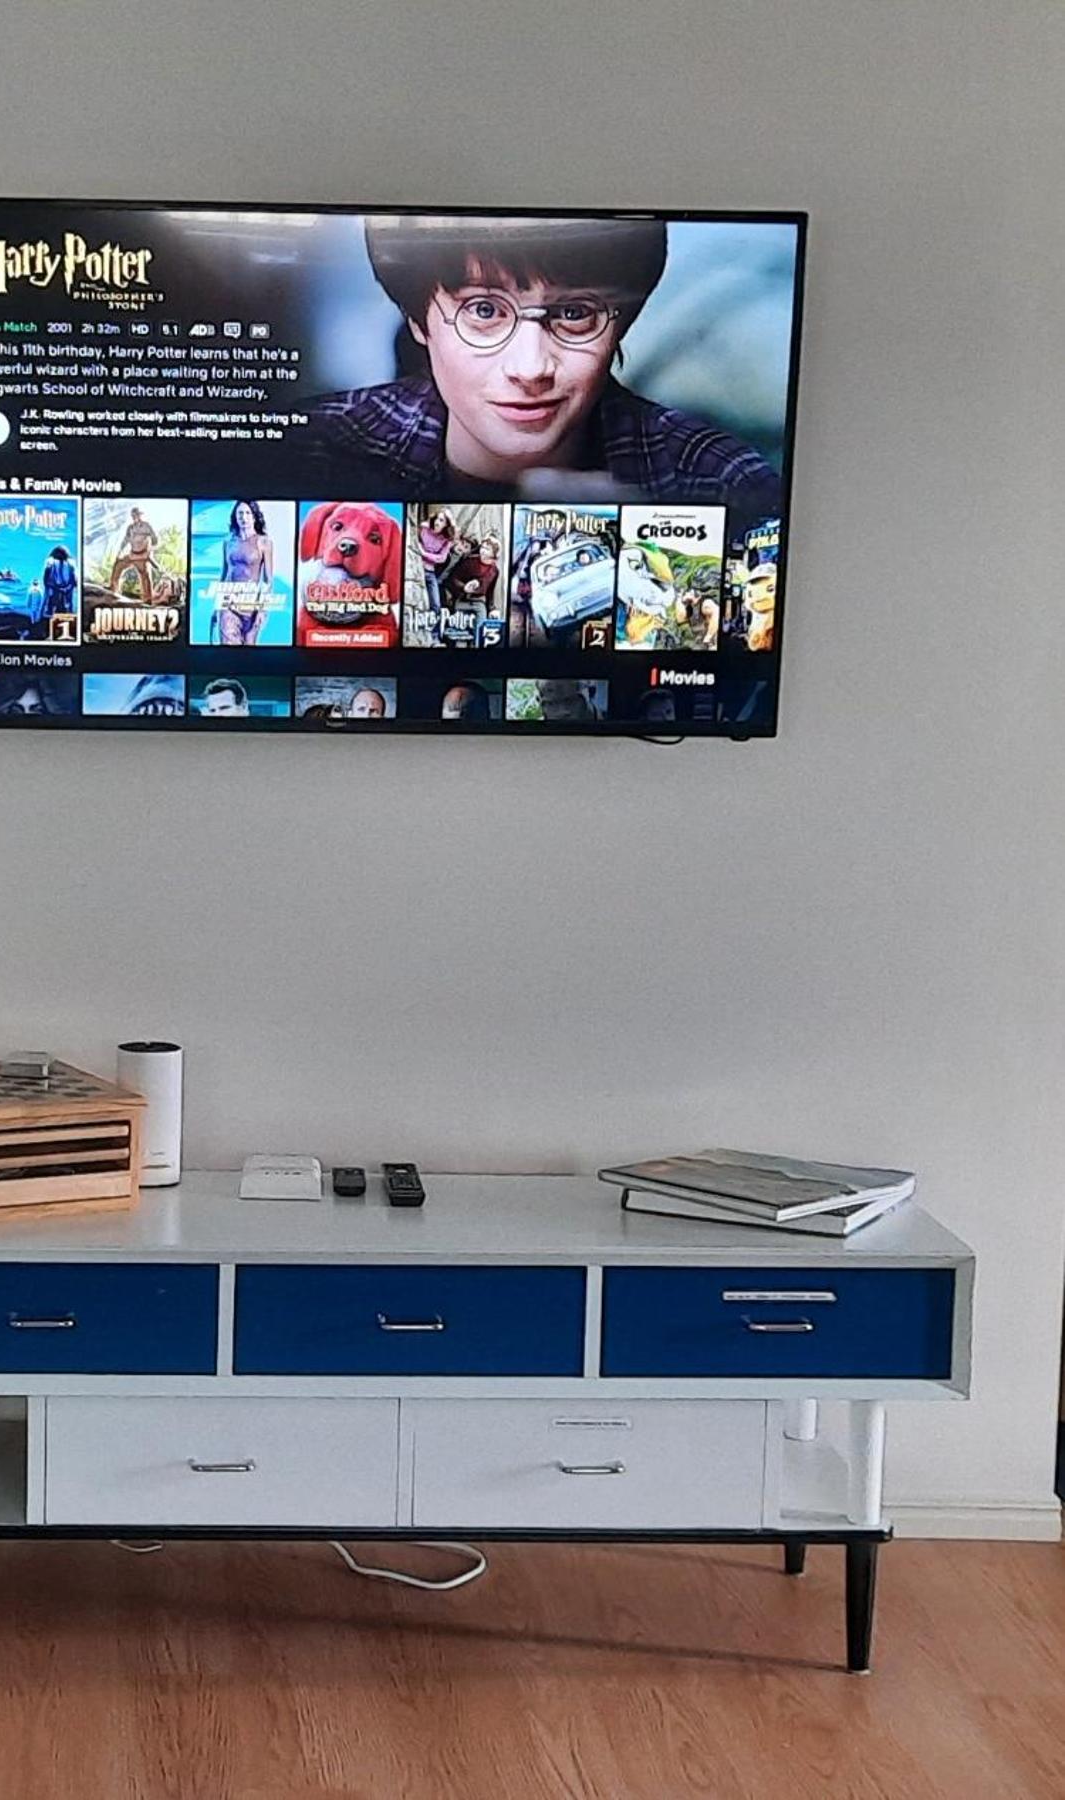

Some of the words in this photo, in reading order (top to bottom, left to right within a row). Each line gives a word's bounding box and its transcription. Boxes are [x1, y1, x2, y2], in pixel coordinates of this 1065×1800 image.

[64, 233, 152, 293] Potter
[3, 322, 37, 332] Match
[47, 323, 72, 333] 2001
[81, 323, 94, 333] 2h
[97, 323, 120, 334] 32m
[0, 343, 18, 356] his
[22, 344, 45, 356] 11th
[48, 345, 106, 360] birthday,
[109, 346, 144, 360] Harry
[147, 346, 187, 359] Potter
[190, 347, 230, 360] learns
[233, 348, 259, 360] that
[261, 348, 288, 361] he's
[290, 351, 299, 361] a
[36, 364, 78, 376] wizard
[81, 364, 108, 376] with
[111, 367, 120, 377] a
[123, 364, 159, 379] place
[161, 366, 208, 381] waiting
[211, 366, 230, 379] for
[233, 366, 257, 379] him
[259, 368, 274, 379] at
[276, 368, 298, 380] the
[42, 383, 87, 395] School
[90, 384, 105, 395] of
[107, 384, 176, 397] Witchcraft
[178, 386, 204, 398] and
[206, 386, 268, 400] Wizardry.
[43, 409, 84, 422] Rowling
[87, 410, 126, 420] worked
[128, 411, 164, 423] closely
[166, 412, 188, 421] with
[189, 412, 247, 422] filmmakers
[249, 413, 260, 423] to
[262, 413, 289, 425] bring
[291, 413, 308, 424] the
[20, 424, 52, 434] iconic
[54, 425, 109, 436] characters
[111, 425, 135, 436] from
[137, 426, 154, 436] her
[156, 427, 218, 440] best-selling
[253, 429, 265, 438] to
[266, 428, 283, 438] the
[10, 478, 21, 490] &
[24, 478, 69, 493] Family
[72, 479, 122, 492] Movies
[24, 504, 68, 533] Potter
[526, 511, 566, 537] Harry
[565, 508, 609, 540] Potter
[637, 523, 707, 541] CROODS
[57, 621, 75, 640] 1
[311, 633, 352, 644] Recently
[354, 633, 384, 643] Added
[589, 629, 605, 648] 2
[24, 654, 72, 667] Movies
[660, 670, 715, 686] Movies
